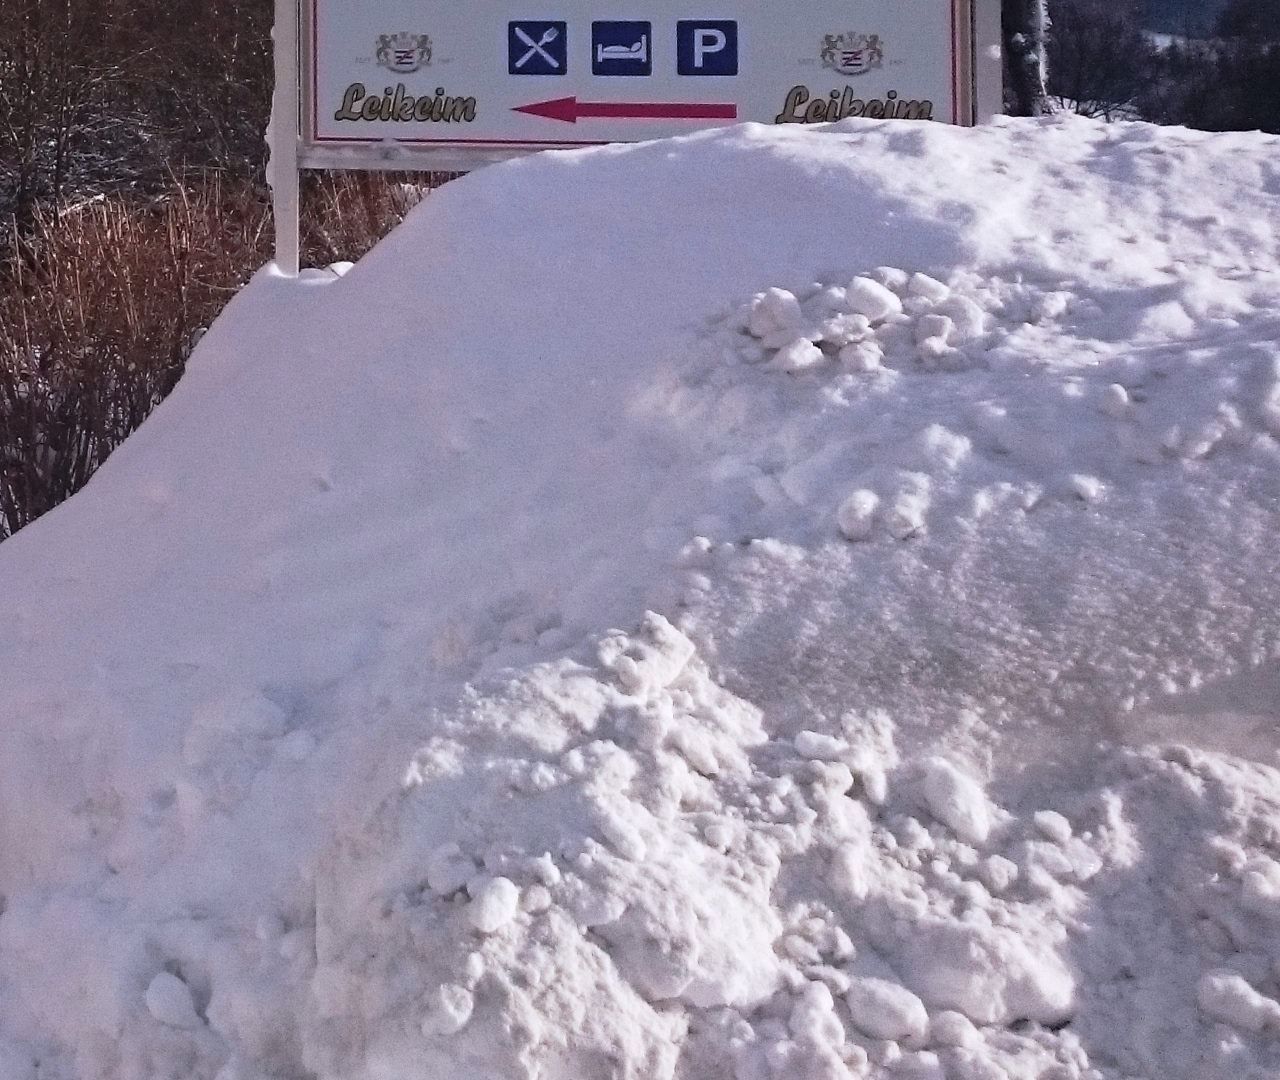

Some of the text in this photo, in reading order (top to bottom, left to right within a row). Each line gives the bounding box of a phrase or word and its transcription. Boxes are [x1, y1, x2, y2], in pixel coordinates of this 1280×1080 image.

[693, 28, 727, 68] P
[334, 82, 477, 123] Leikeim
[774, 84, 934, 124] Leikeim
